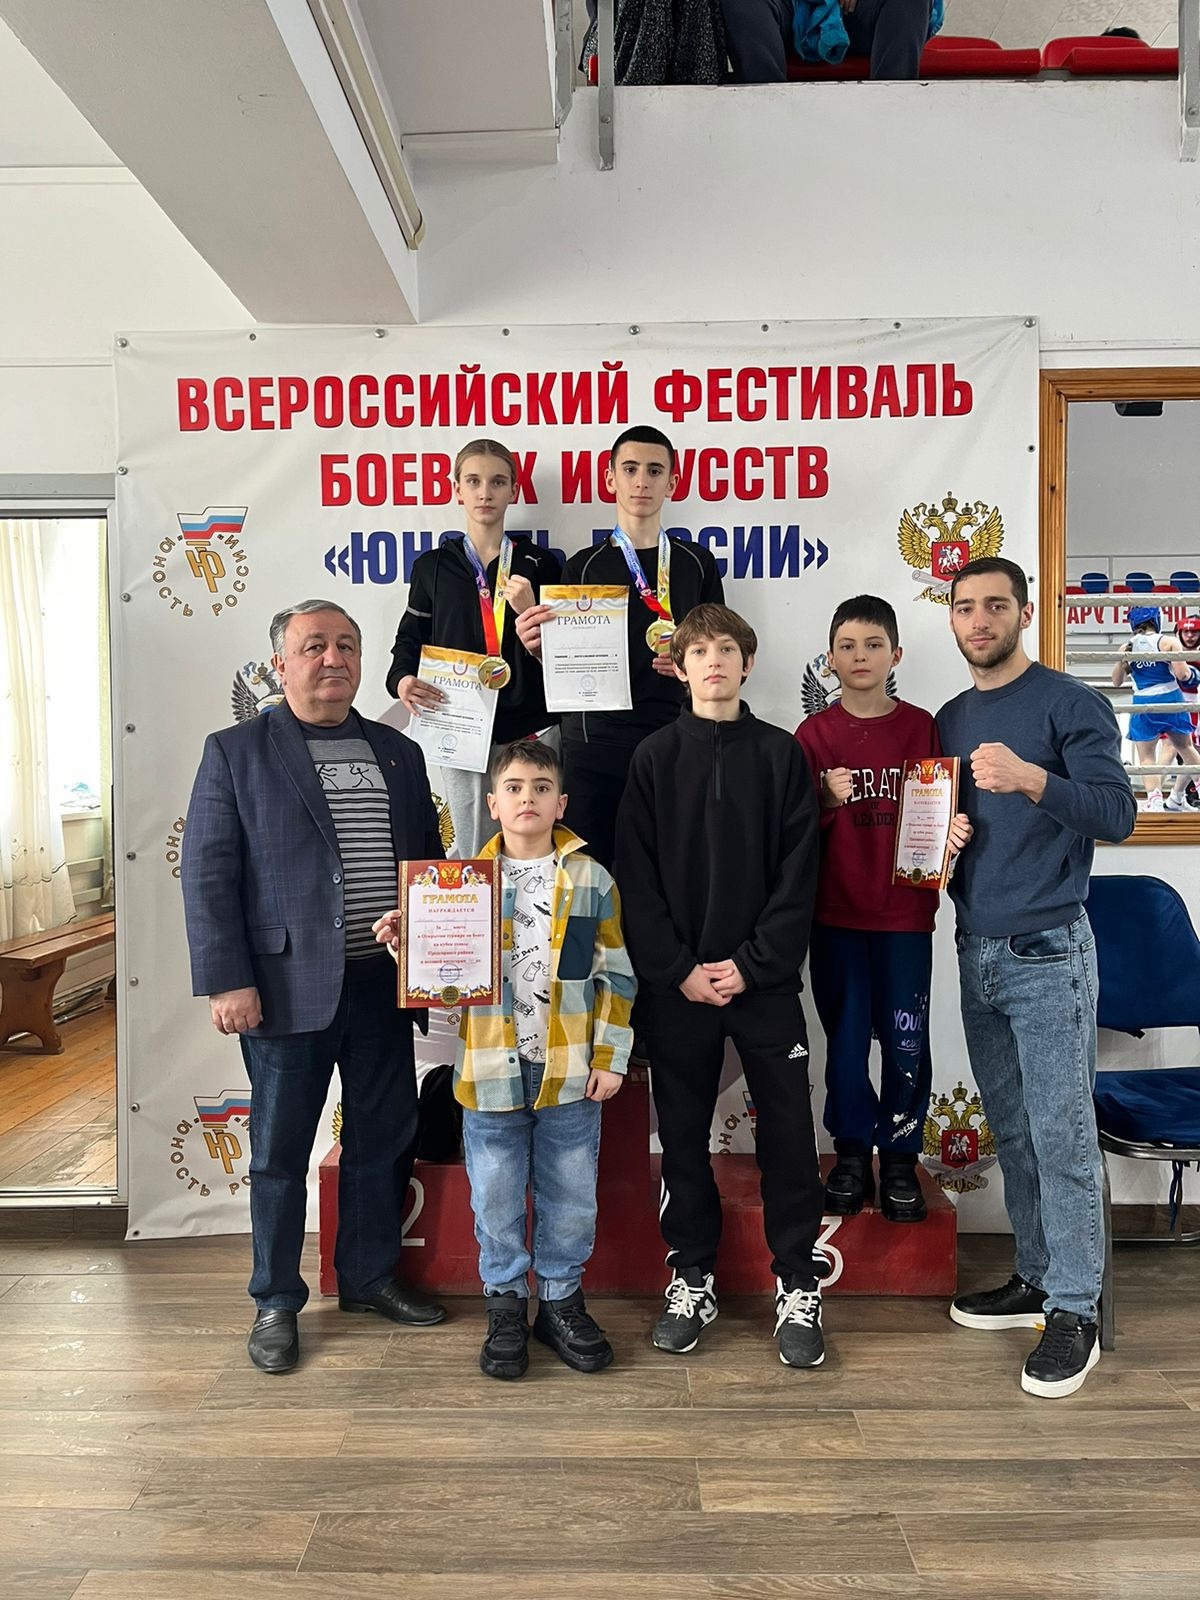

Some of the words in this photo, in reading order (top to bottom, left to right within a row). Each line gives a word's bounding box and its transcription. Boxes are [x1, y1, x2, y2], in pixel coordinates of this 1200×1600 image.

[177, 361, 629, 432] ВСЕРОССИЙСКИЙ
[654, 362, 974, 424] ФЕСТИВАЛЬ
[320, 451, 538, 507] БОЕВХ
[561, 445, 829, 504] ИСУССТВ
[557, 615, 611, 626] ГРАМОТА
[433, 674, 482, 691] ГРАМОТА
[421, 893, 479, 905] ГРАМОТА
[788, 1049, 808, 1060] adidas
[401, 1178, 425, 1246] 2
[817, 1216, 844, 1288] 3
